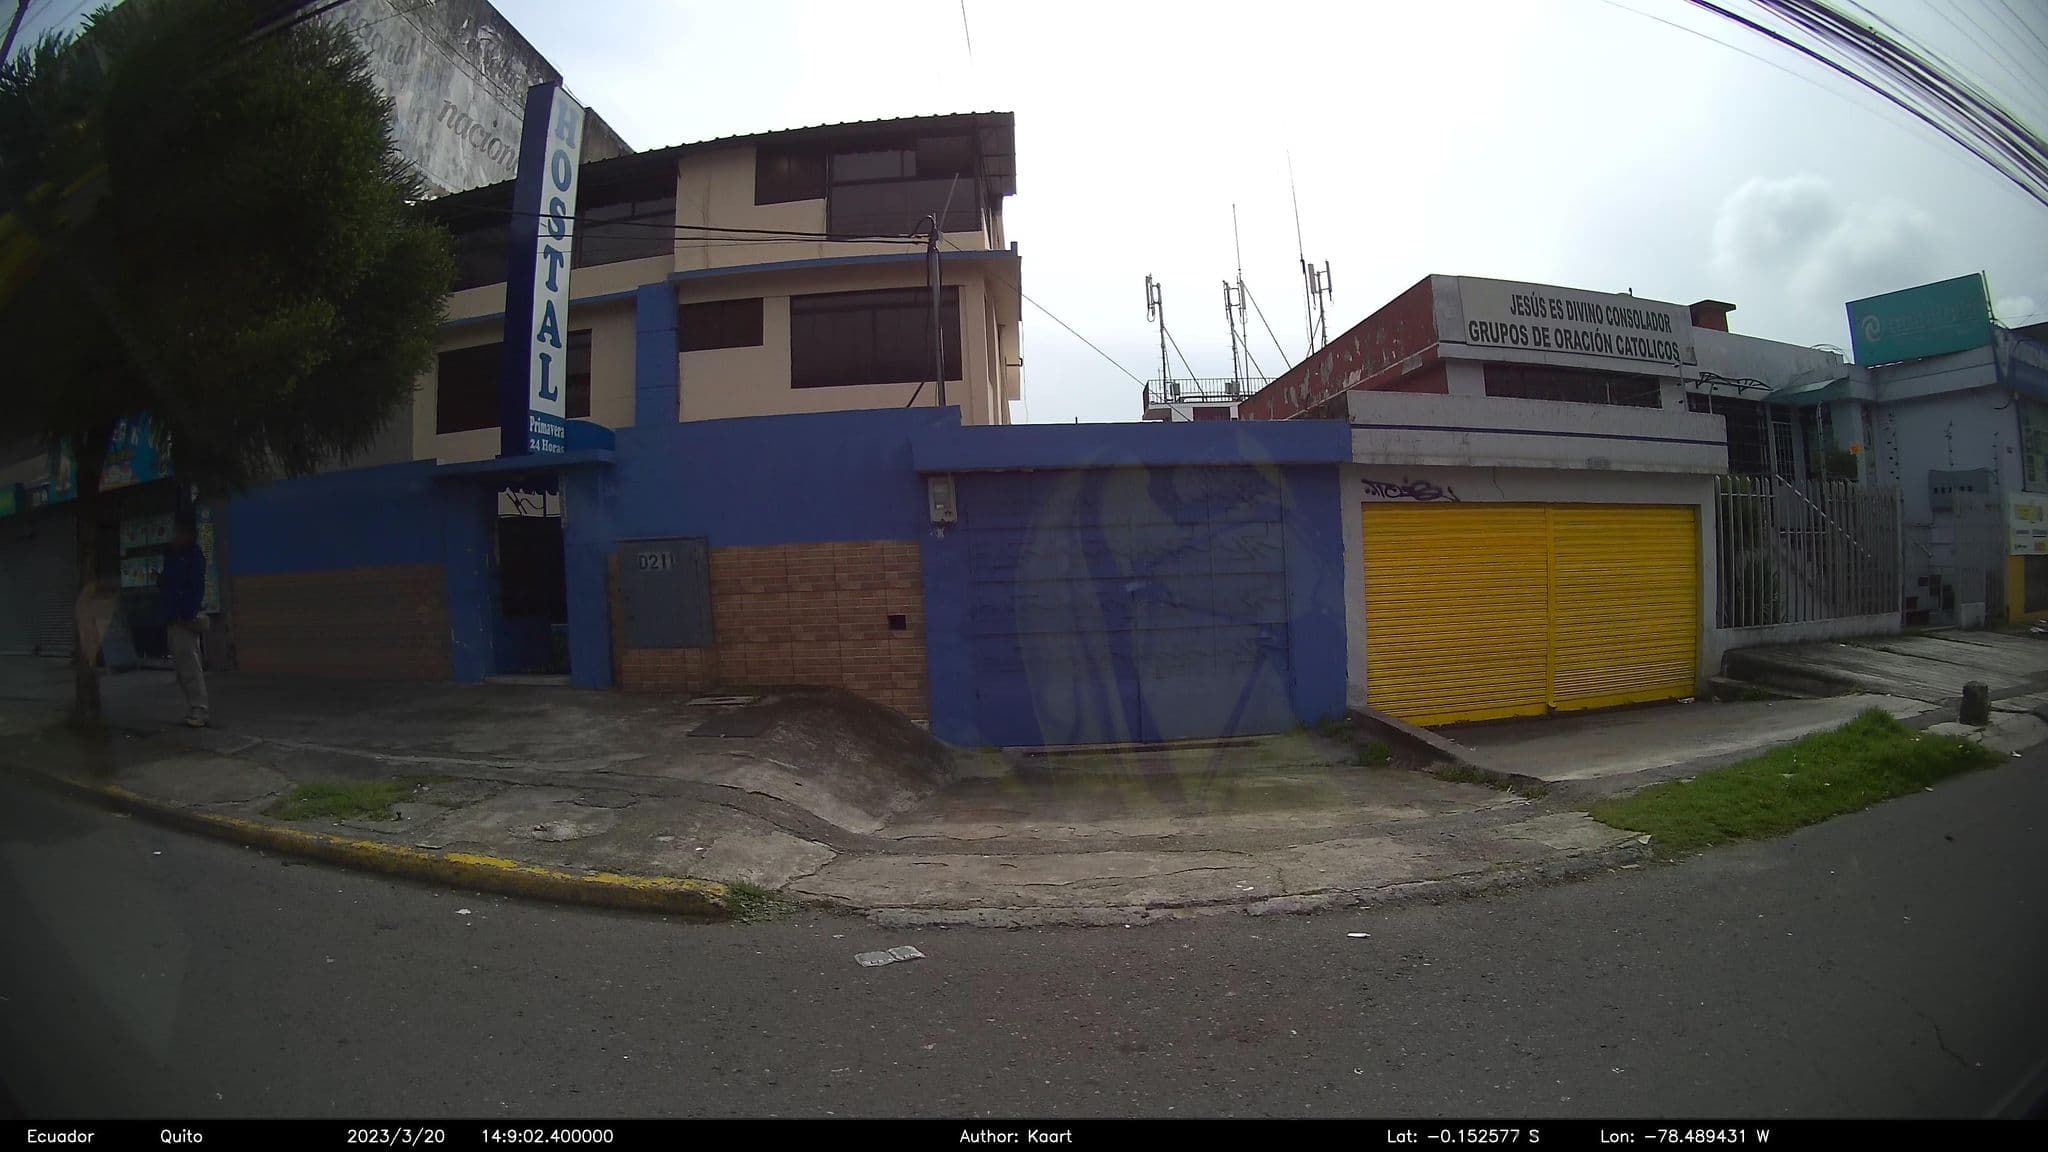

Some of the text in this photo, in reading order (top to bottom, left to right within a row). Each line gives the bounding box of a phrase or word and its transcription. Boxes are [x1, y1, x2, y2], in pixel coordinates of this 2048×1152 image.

[537, 102, 577, 402] HOSTAL
[1510, 291, 1672, 334] JESÚS ES DIVINO CONSOLADOR
[1468, 320, 1680, 361] GRUPOS DE ORACIÓN CATOLICOS
[529, 415, 565, 439] Primavera
[530, 438, 565, 454] 24 Horas
